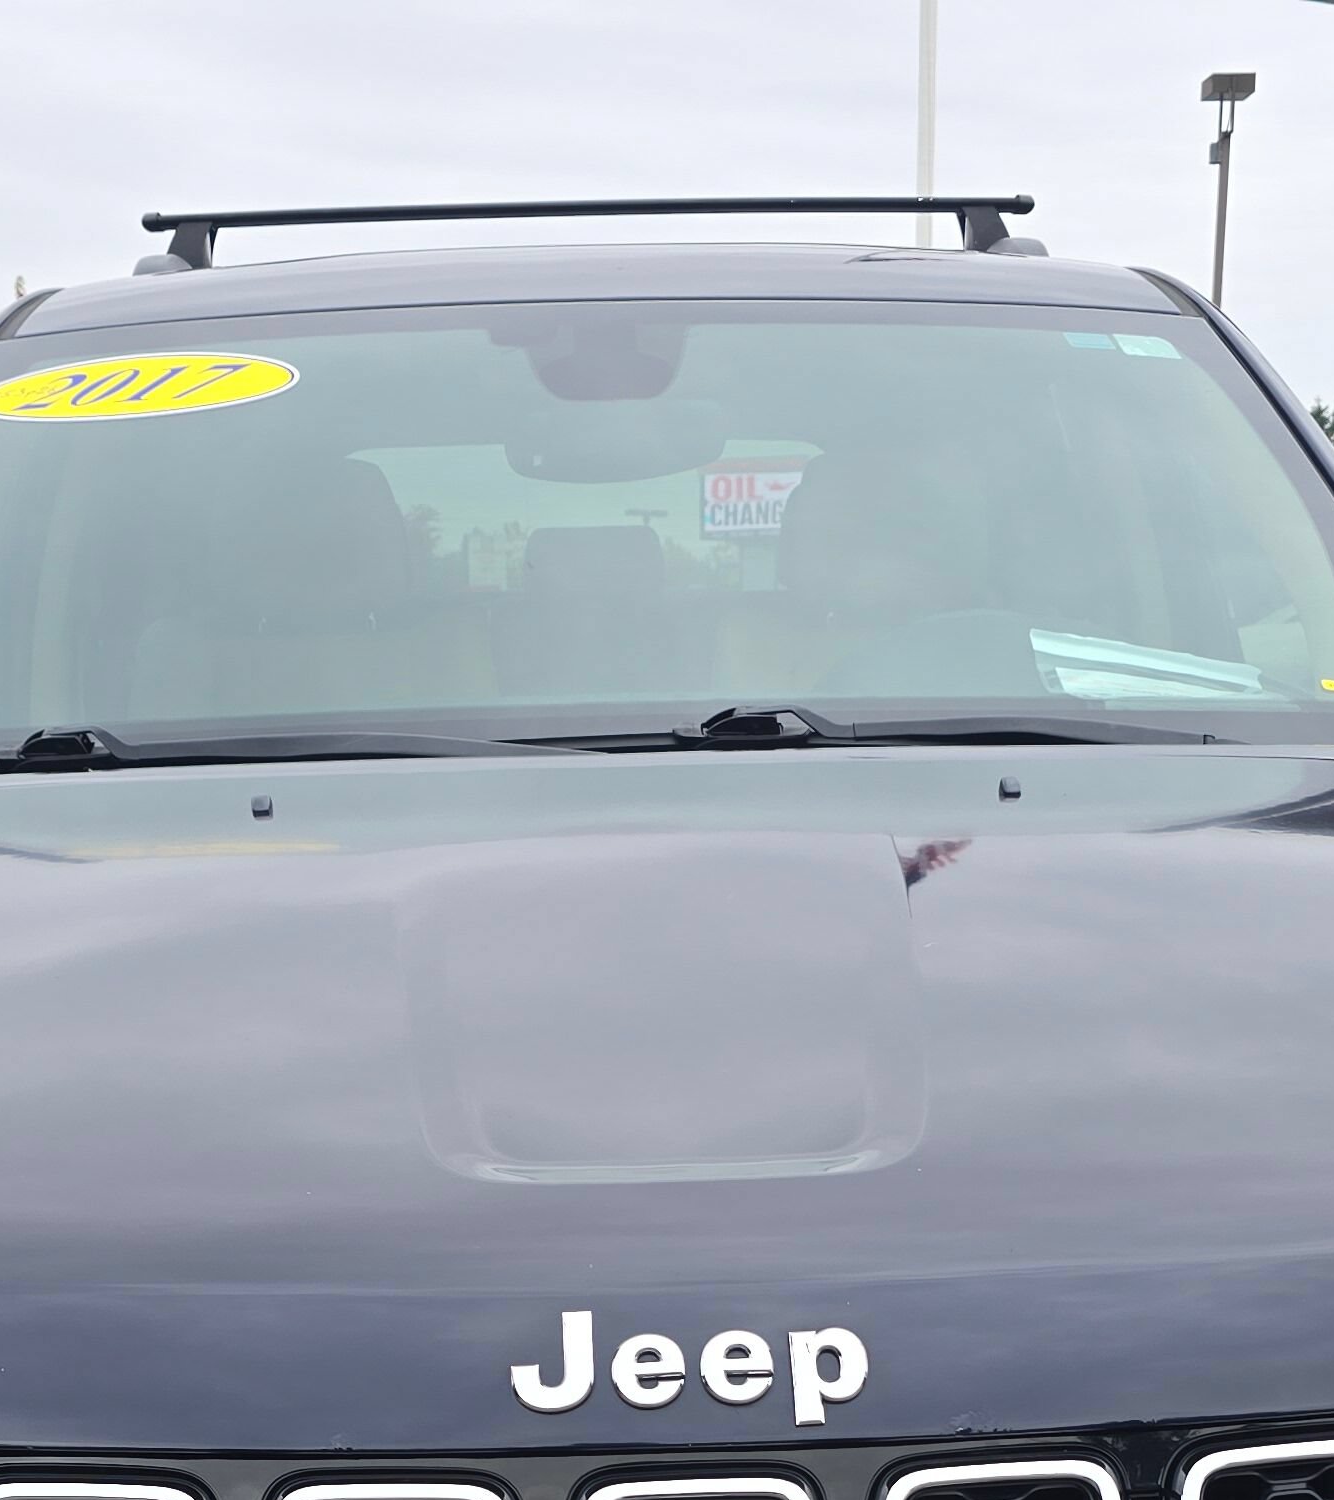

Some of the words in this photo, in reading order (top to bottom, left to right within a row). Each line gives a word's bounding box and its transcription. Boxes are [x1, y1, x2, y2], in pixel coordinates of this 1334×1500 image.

[11, 363, 252, 411] 2017
[711, 475, 764, 502] OIL
[510, 1310, 868, 1427] Jeep
